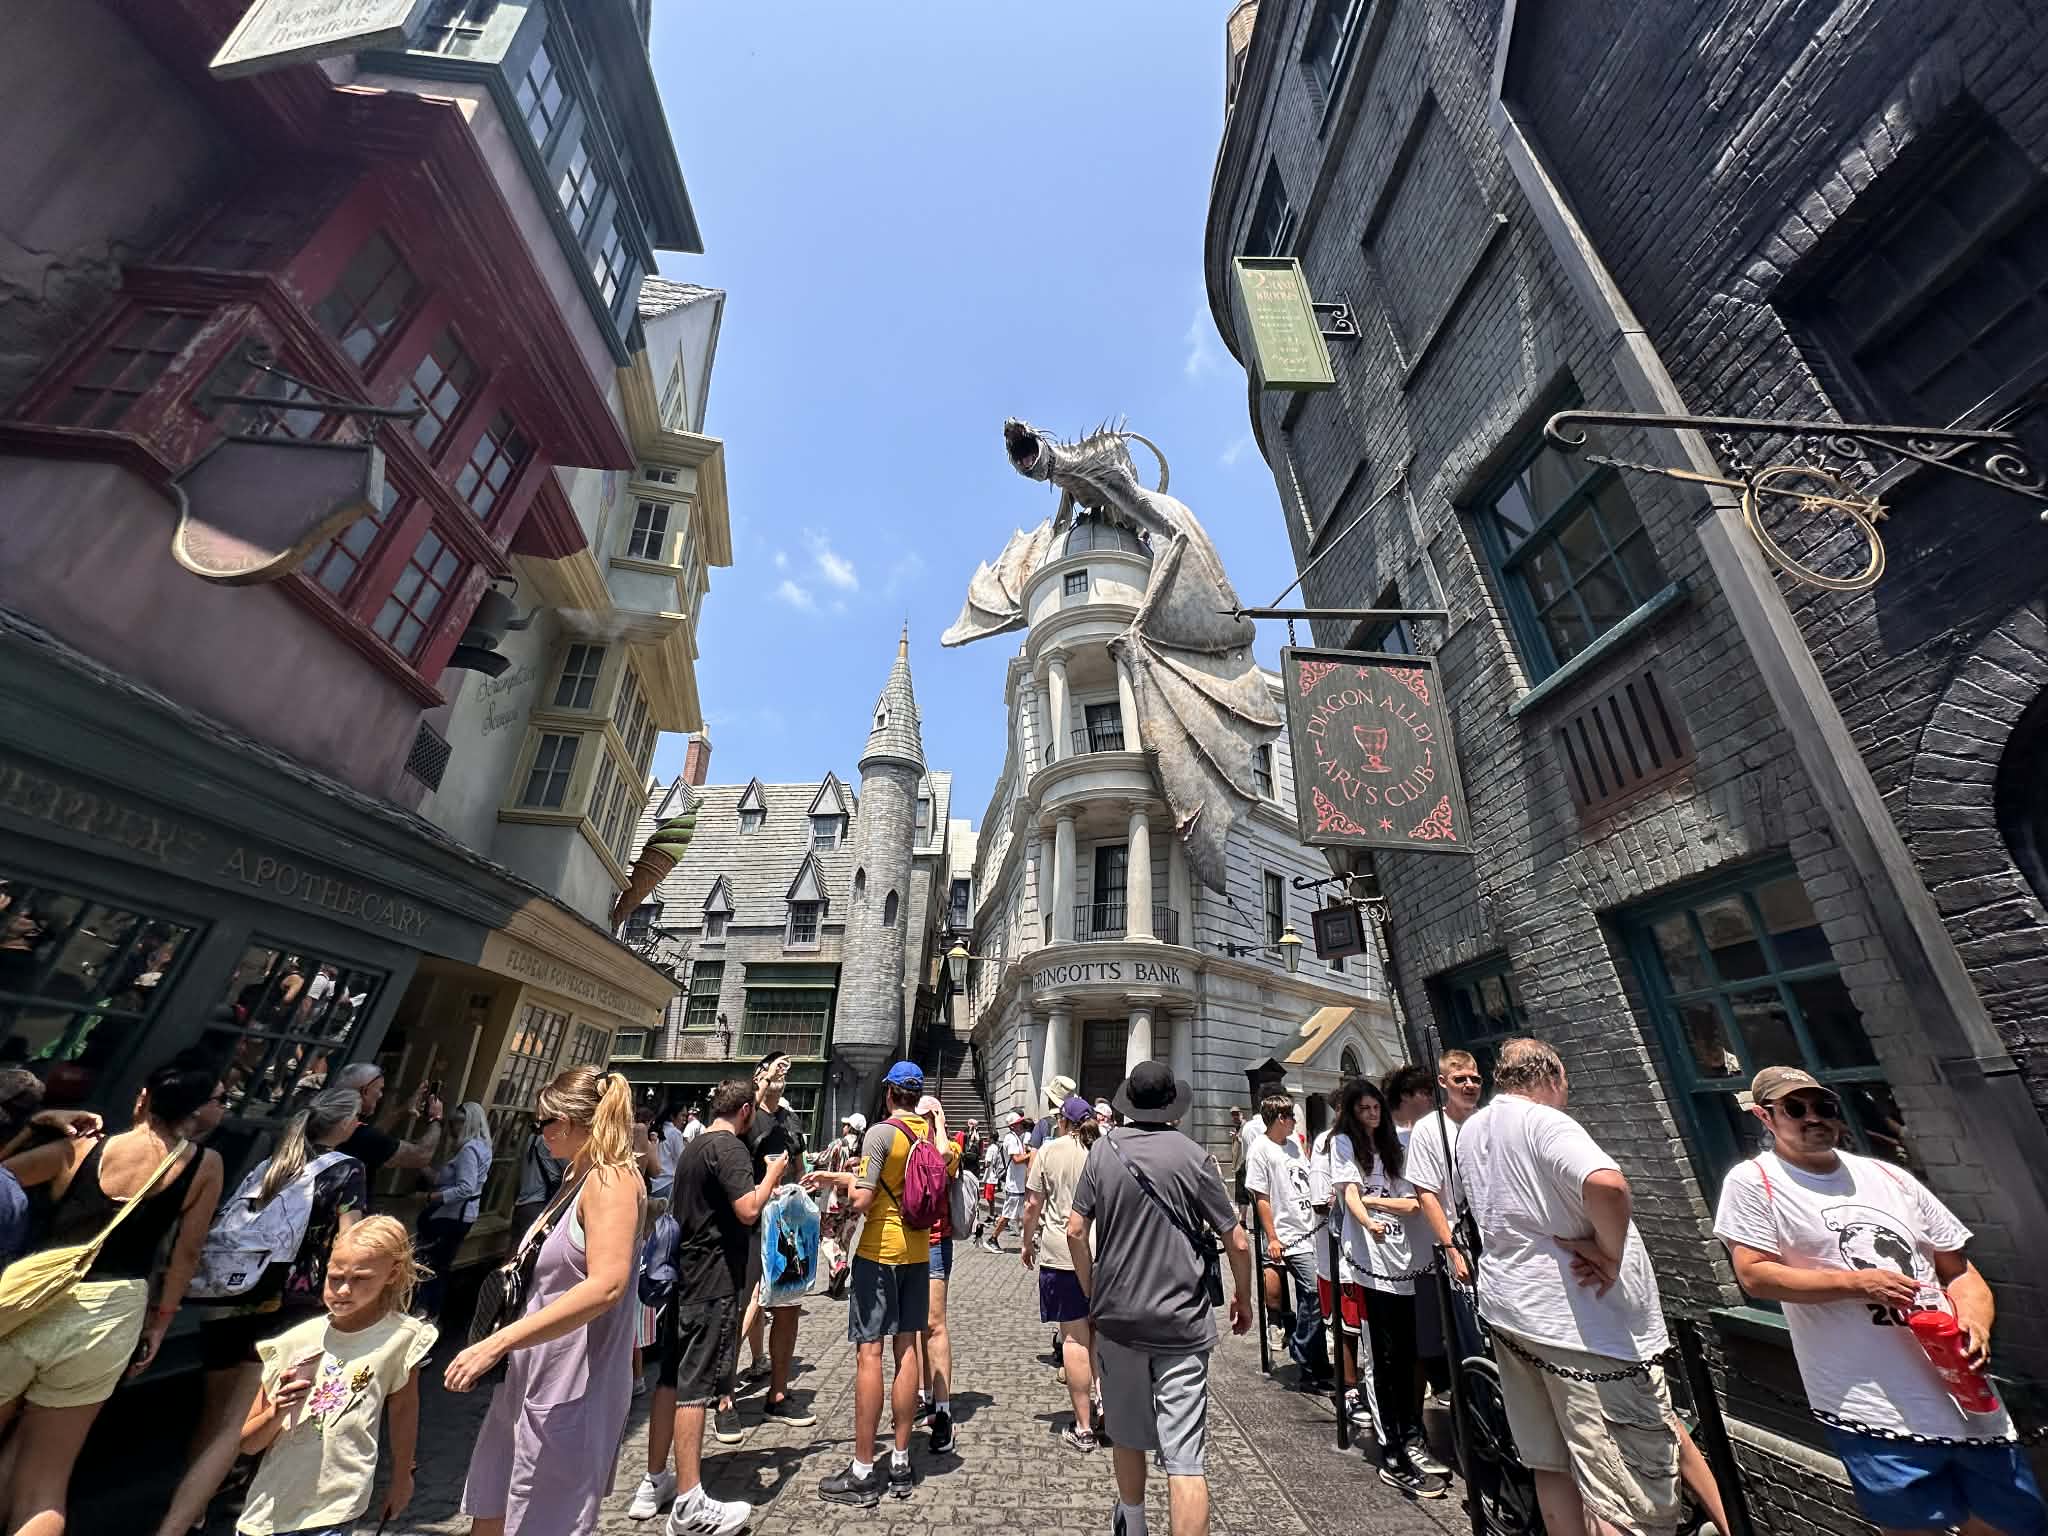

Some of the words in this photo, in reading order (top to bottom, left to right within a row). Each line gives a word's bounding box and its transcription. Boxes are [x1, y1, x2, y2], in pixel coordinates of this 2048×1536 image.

[1306, 688, 1375, 737] DIAGON
[1379, 695, 1437, 745] ALLEY
[1318, 758, 1378, 806] ARTS
[1384, 765, 1436, 807] CLUB
[216, 847, 432, 936] APOTHECARY
[1032, 962, 1121, 989] GRINGOTTS
[1136, 963, 1181, 984] BANK
